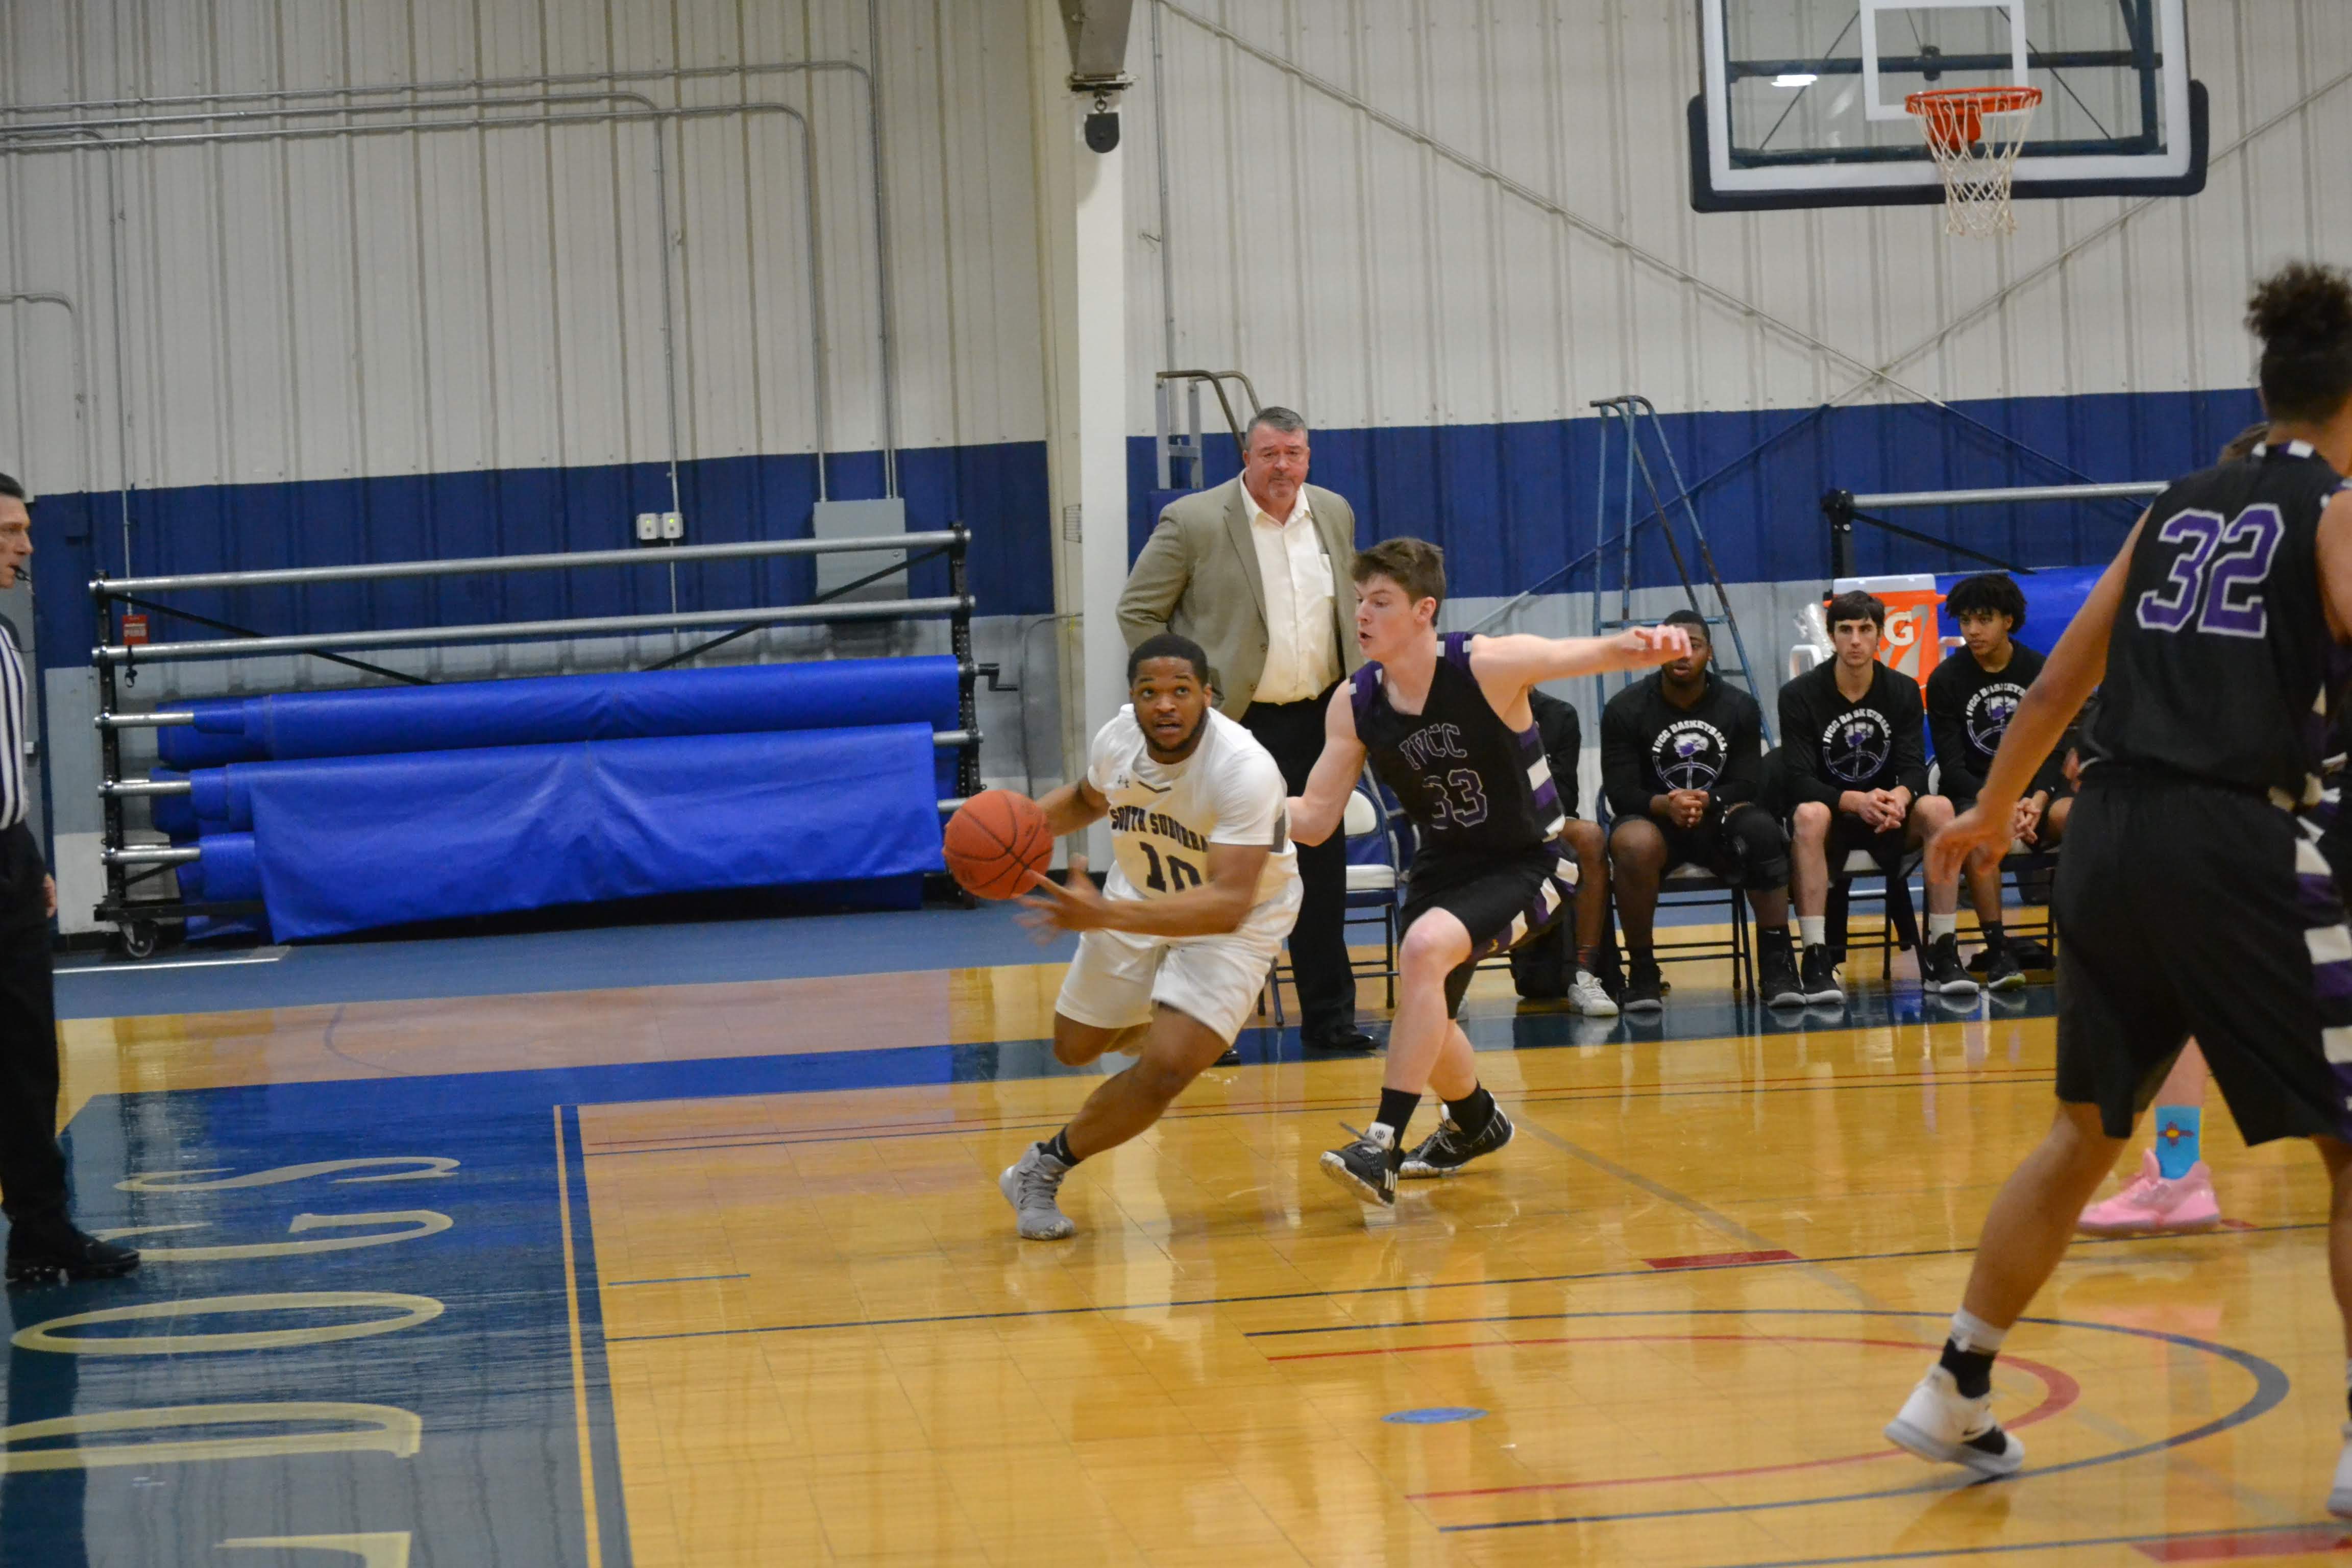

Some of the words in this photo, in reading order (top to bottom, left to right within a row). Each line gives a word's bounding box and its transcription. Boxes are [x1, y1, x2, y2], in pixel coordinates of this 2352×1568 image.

[2136, 502, 2285, 640] 32
[1883, 610, 1915, 646] G
[1398, 722, 1467, 770] IVCC
[1651, 728, 1673, 753] IVCC
[1668, 719, 1728, 752] BASKETBALL
[1822, 719, 1841, 744] IVCC
[1422, 768, 1488, 830] 33
[1109, 805, 1147, 832] SOUTH
